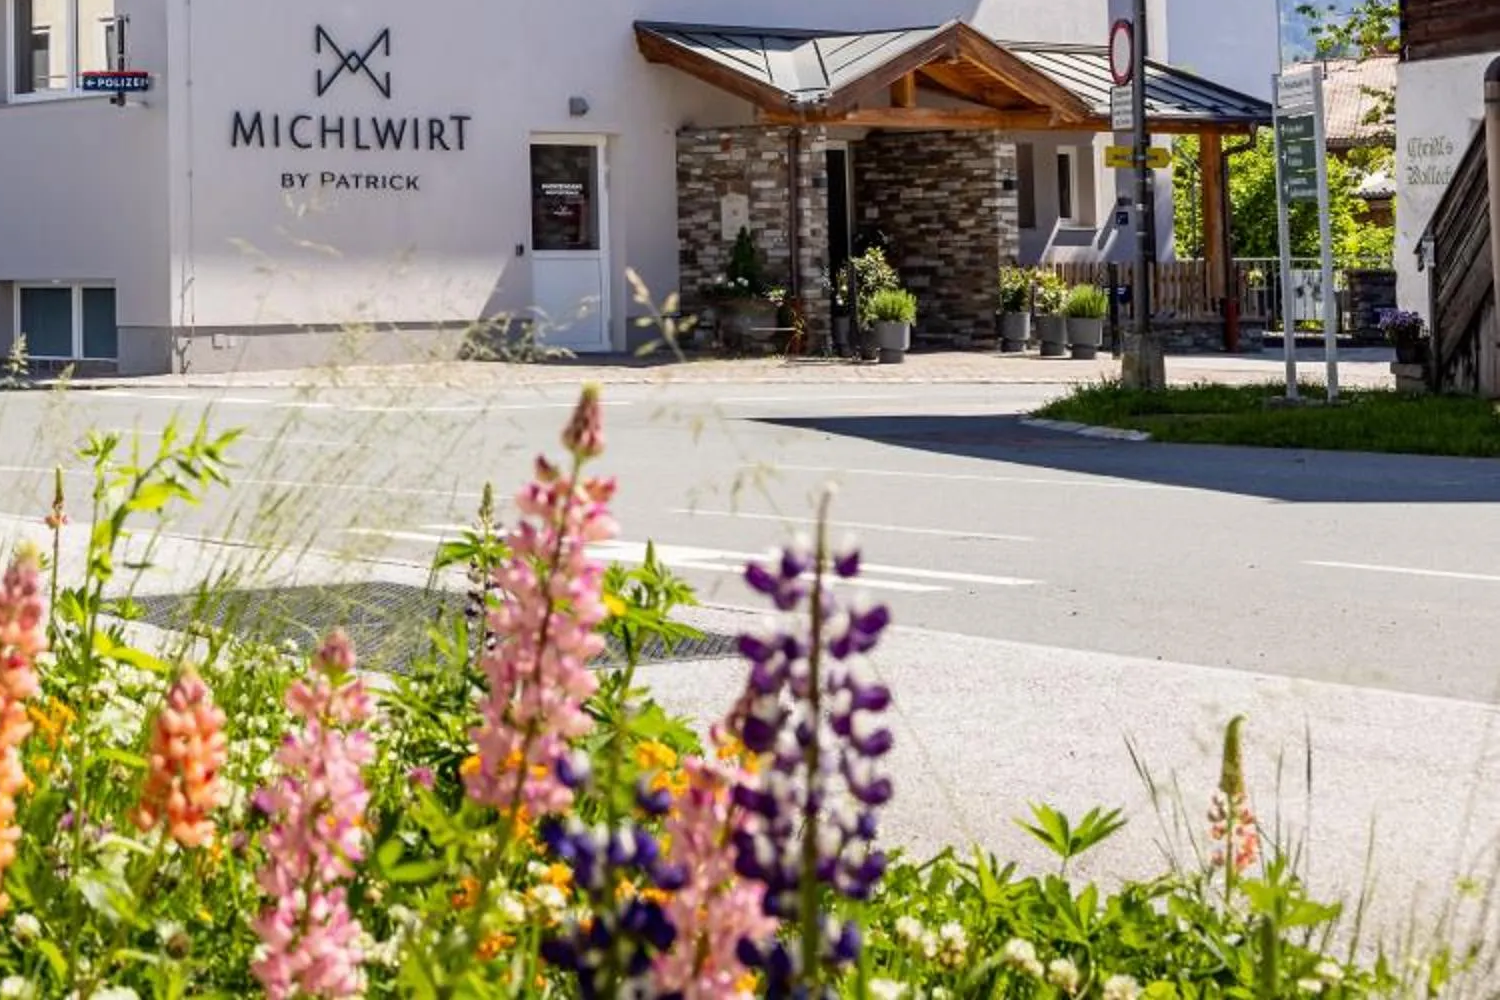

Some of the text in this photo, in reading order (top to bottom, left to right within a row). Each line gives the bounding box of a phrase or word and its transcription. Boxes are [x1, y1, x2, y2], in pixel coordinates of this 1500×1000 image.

[97, 77, 146, 88] POLIZEI
[231, 111, 472, 151] MICHLWIRT
[281, 171, 421, 191] BY PATRICK
